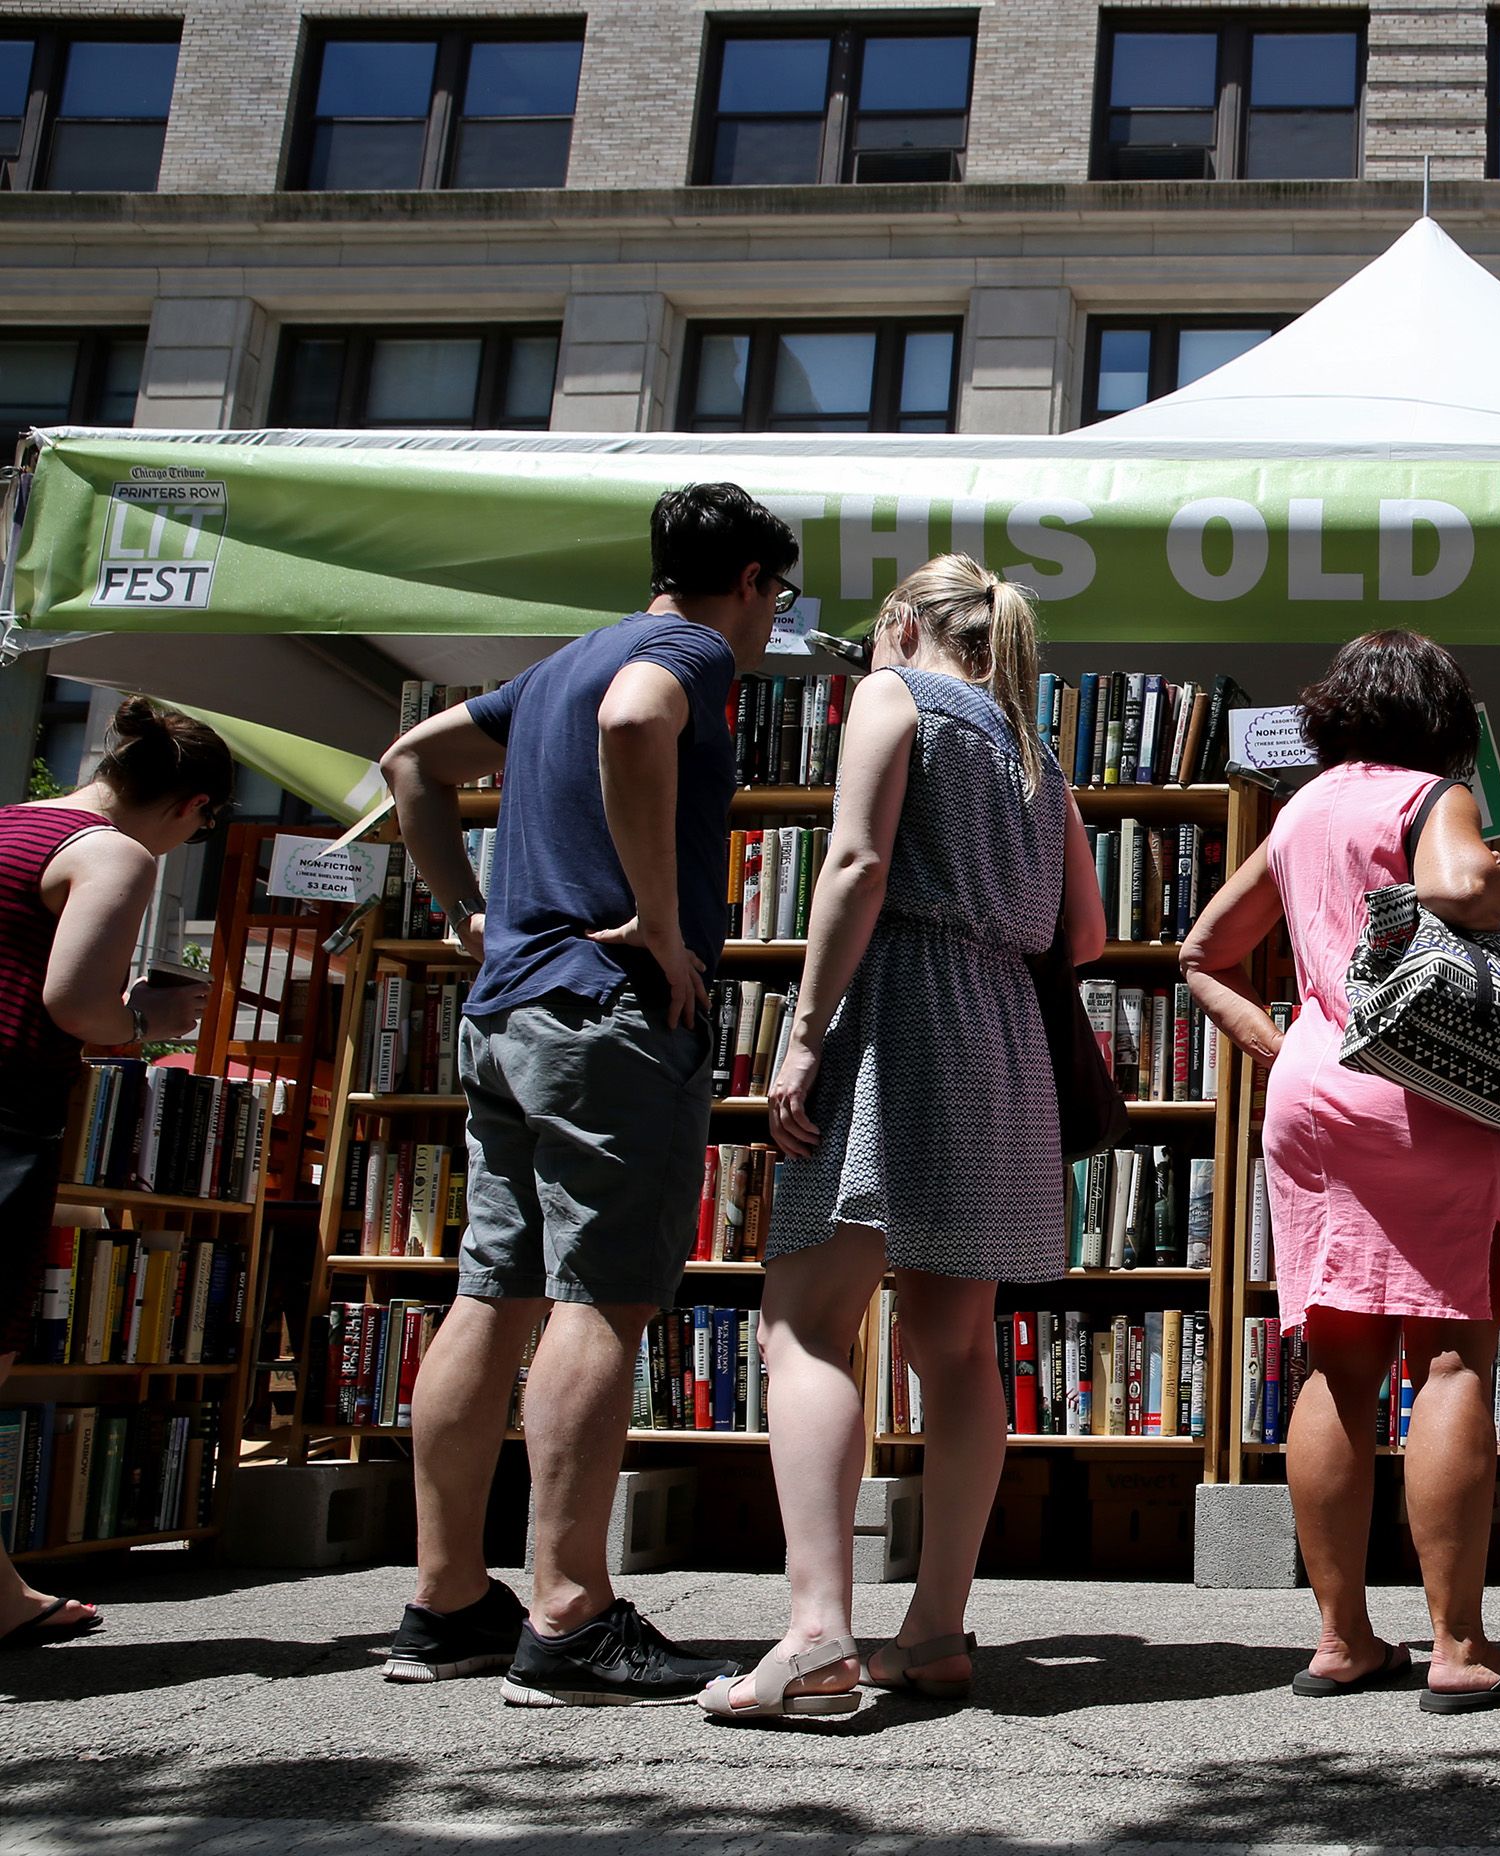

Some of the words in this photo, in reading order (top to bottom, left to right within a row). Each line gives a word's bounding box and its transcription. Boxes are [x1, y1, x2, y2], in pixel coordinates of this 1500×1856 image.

[131, 466, 168, 480] Chicago
[168, 466, 206, 480] Tribune
[118, 486, 187, 500] PRINTERS
[190, 486, 221, 499] ROW
[108, 502, 224, 559] LIT
[750, 495, 1097, 602] THIS
[1166, 496, 1475, 602] OLD
[100, 566, 210, 603] FEST
[1267, 750, 1279, 758] $3
[1281, 749, 1307, 757] EACH
[1179, 827, 1188, 856] CHARGE
[1186, 827, 1194, 855] TAKING
[780, 841, 792, 866] HEROES
[307, 881, 319, 889] $3
[321, 883, 348, 892] EACH
[389, 981, 400, 1005] DOUBLE
[725, 986, 733, 1008] SONS
[388, 1006, 398, 1027] CROSS
[718, 1023, 729, 1067] BROTHERS
[1174, 1019, 1190, 1082] PATTON
[412, 1147, 428, 1213] COLONEL
[235, 1290, 245, 1323] CLINTON
[722, 1320, 730, 1340] JACK
[1079, 1330, 1087, 1347] SOX
[1182, 1318, 1194, 1347] AMERICAN
[362, 1316, 376, 1376] MINUTEMEN
[1193, 1333, 1205, 1356] RAID
[341, 1344, 352, 1378] DARK
[1055, 1360, 1063, 1376] BIG
[1079, 1354, 1087, 1373] CITY
[1193, 1358, 1204, 1375] ON
[1055, 1380, 1063, 1402] BANG
[1192, 1376, 1204, 1415] TRUMAN
